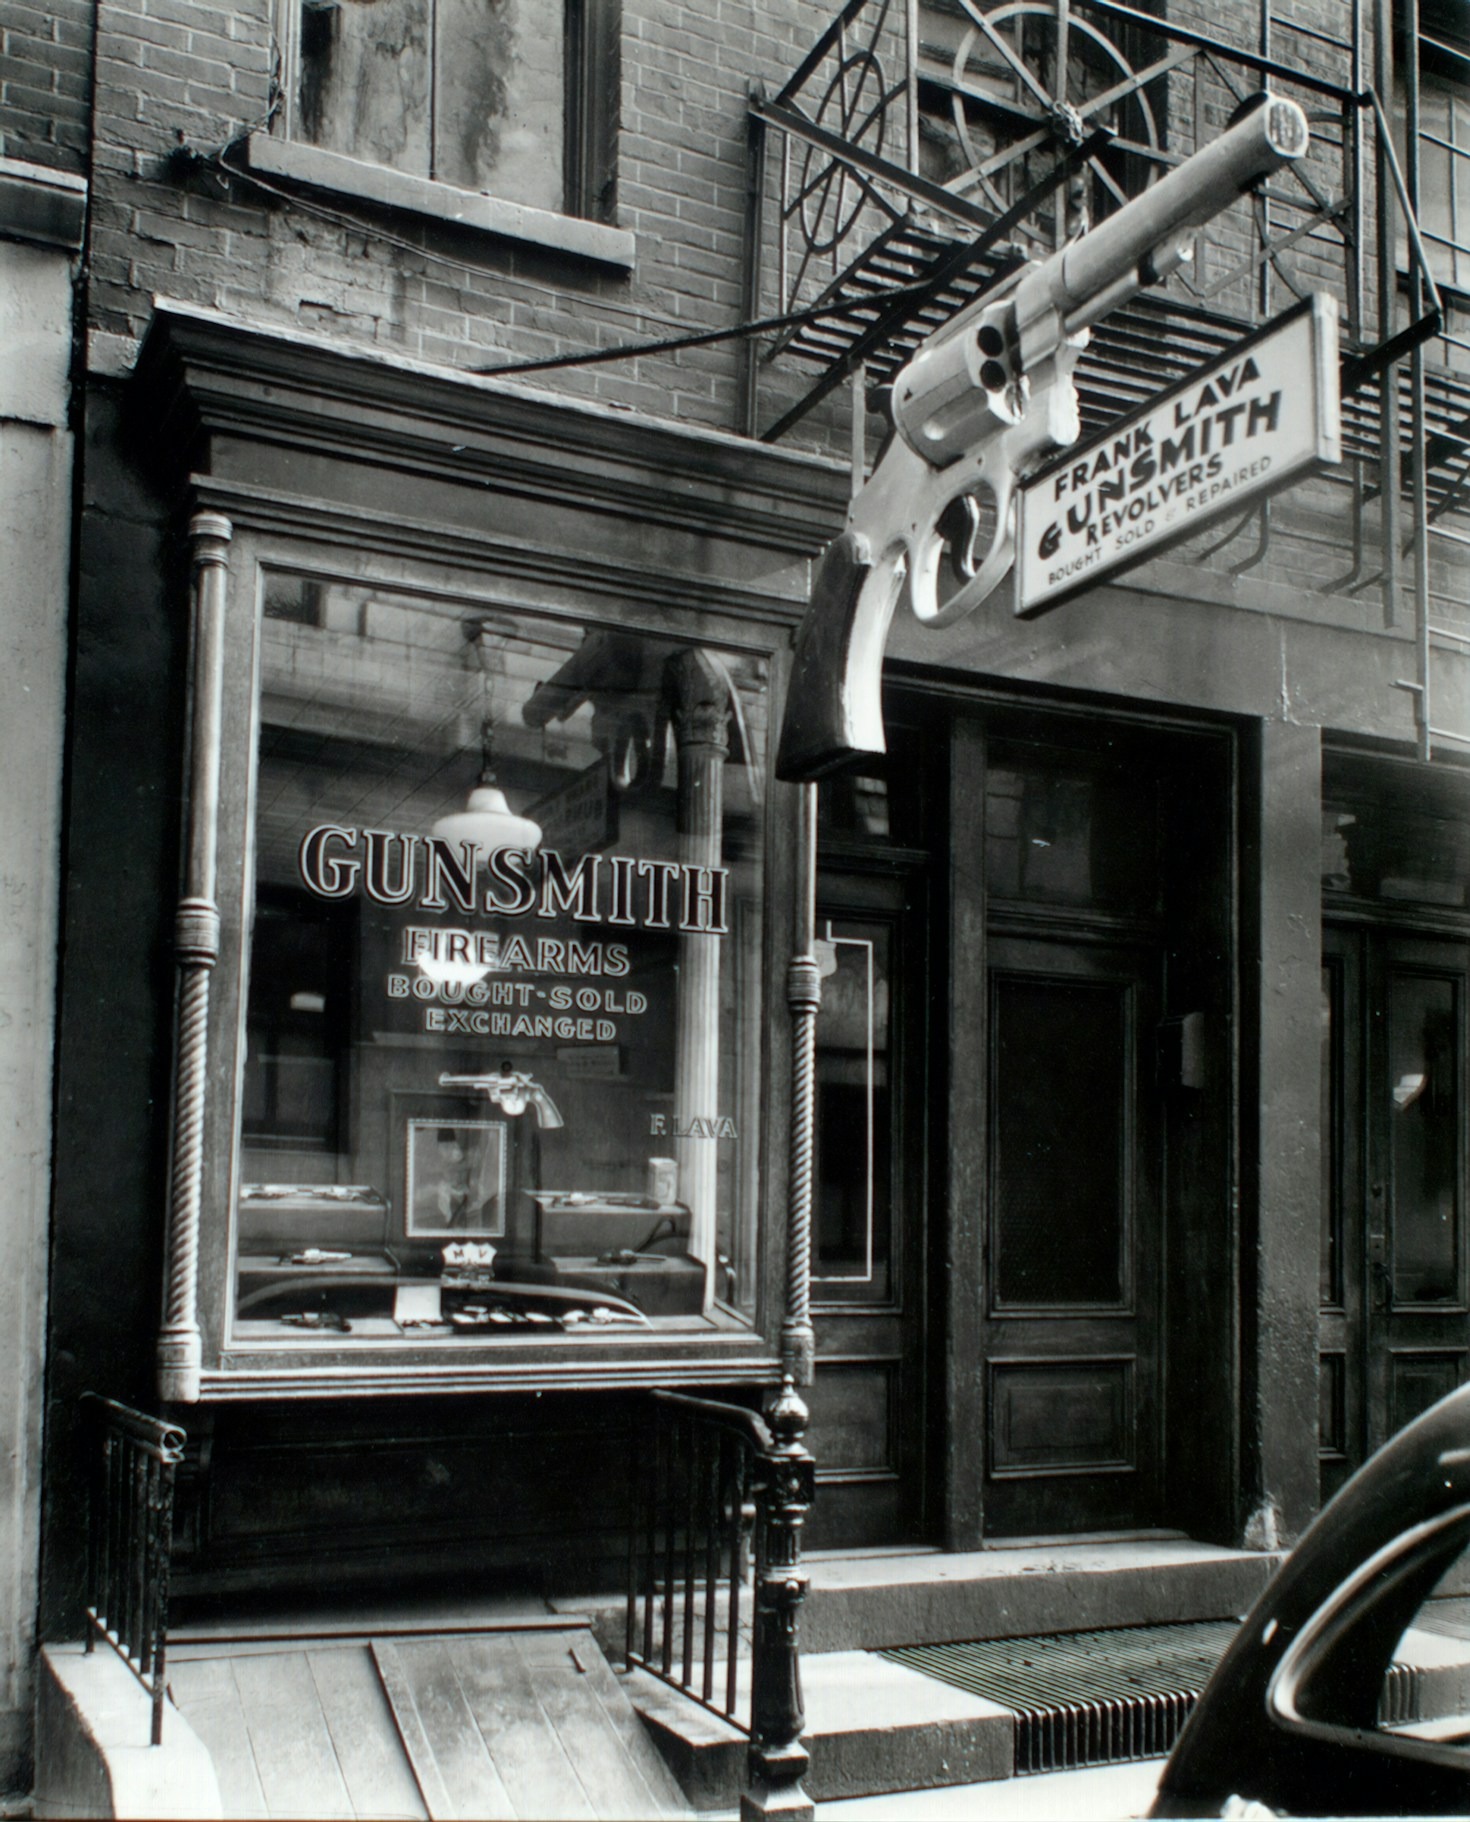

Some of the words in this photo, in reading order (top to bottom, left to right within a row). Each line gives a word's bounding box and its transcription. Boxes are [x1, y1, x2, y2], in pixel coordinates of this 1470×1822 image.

[1038, 389, 1282, 561] GUNSMITH
[1055, 420, 1154, 503] FRANK
[1174, 356, 1261, 430] LAVA
[1048, 547, 1101, 585] BOUGHT
[1115, 519, 1155, 550] SOLD
[1186, 455, 1272, 512] REPAIRED
[1086, 452, 1223, 547] REVOLVERS
[301, 823, 730, 935] GUNSMITH
[401, 925, 631, 977] FIREARMS
[426, 1008, 617, 1040] EXCHANGED
[673, 1114, 738, 1139] LAVA
